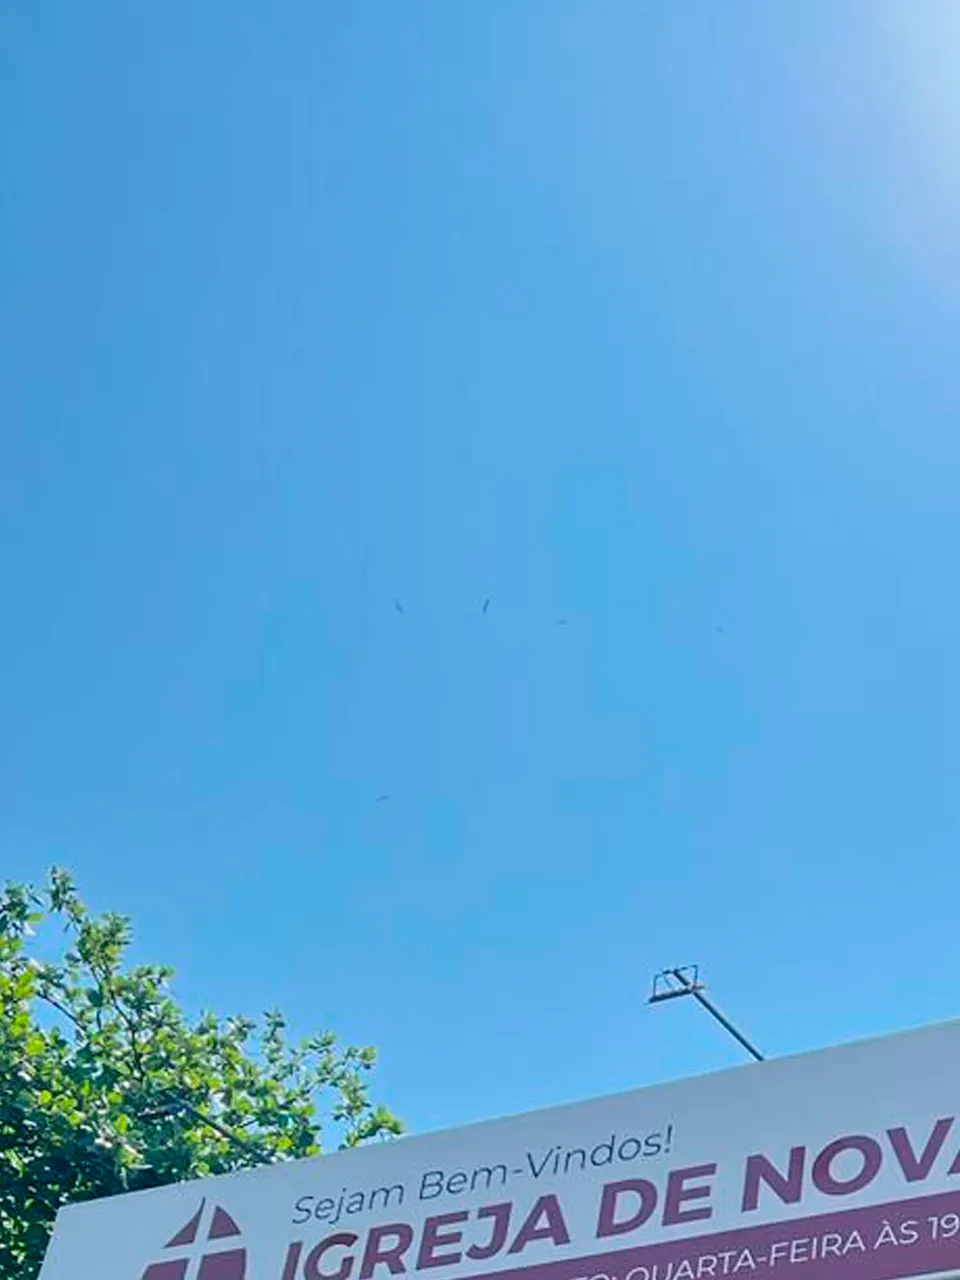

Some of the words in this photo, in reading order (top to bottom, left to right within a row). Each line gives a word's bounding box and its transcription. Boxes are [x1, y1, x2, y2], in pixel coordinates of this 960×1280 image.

[291, 1182, 405, 1227] Sejam
[418, 1124, 674, 1201] Bem-Vindos!
[595, 1162, 718, 1239] DE
[873, 1209, 920, 1249] ÀS
